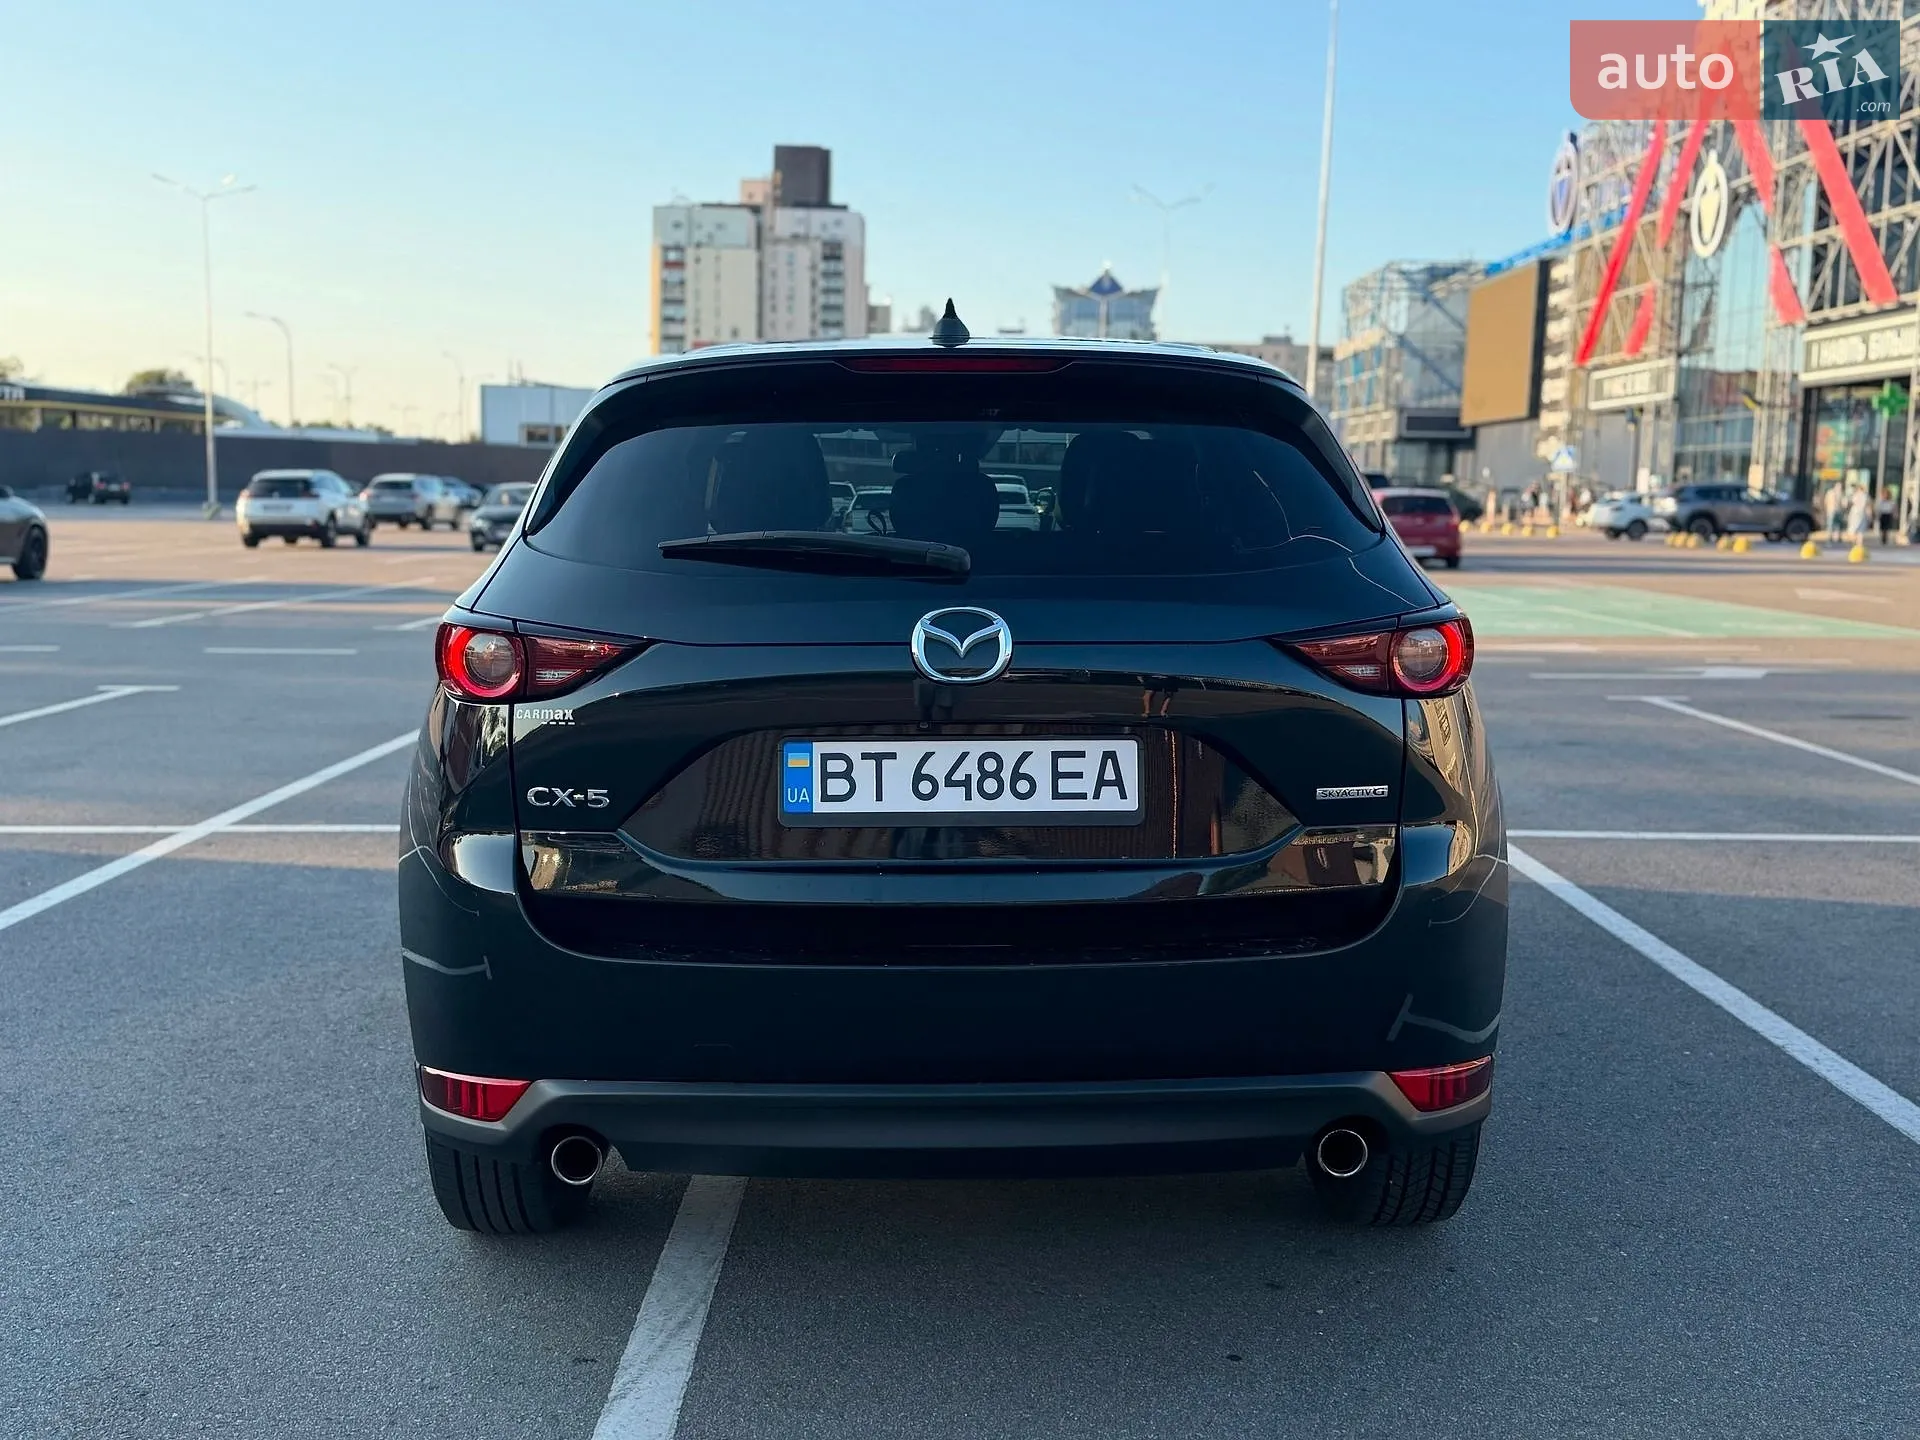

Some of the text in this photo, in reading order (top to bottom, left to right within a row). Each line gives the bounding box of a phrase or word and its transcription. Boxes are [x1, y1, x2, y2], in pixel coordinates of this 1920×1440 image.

[819, 750, 1128, 803] BT 6486 EA
[526, 786, 610, 808] CX-5
[787, 787, 810, 803] UA
